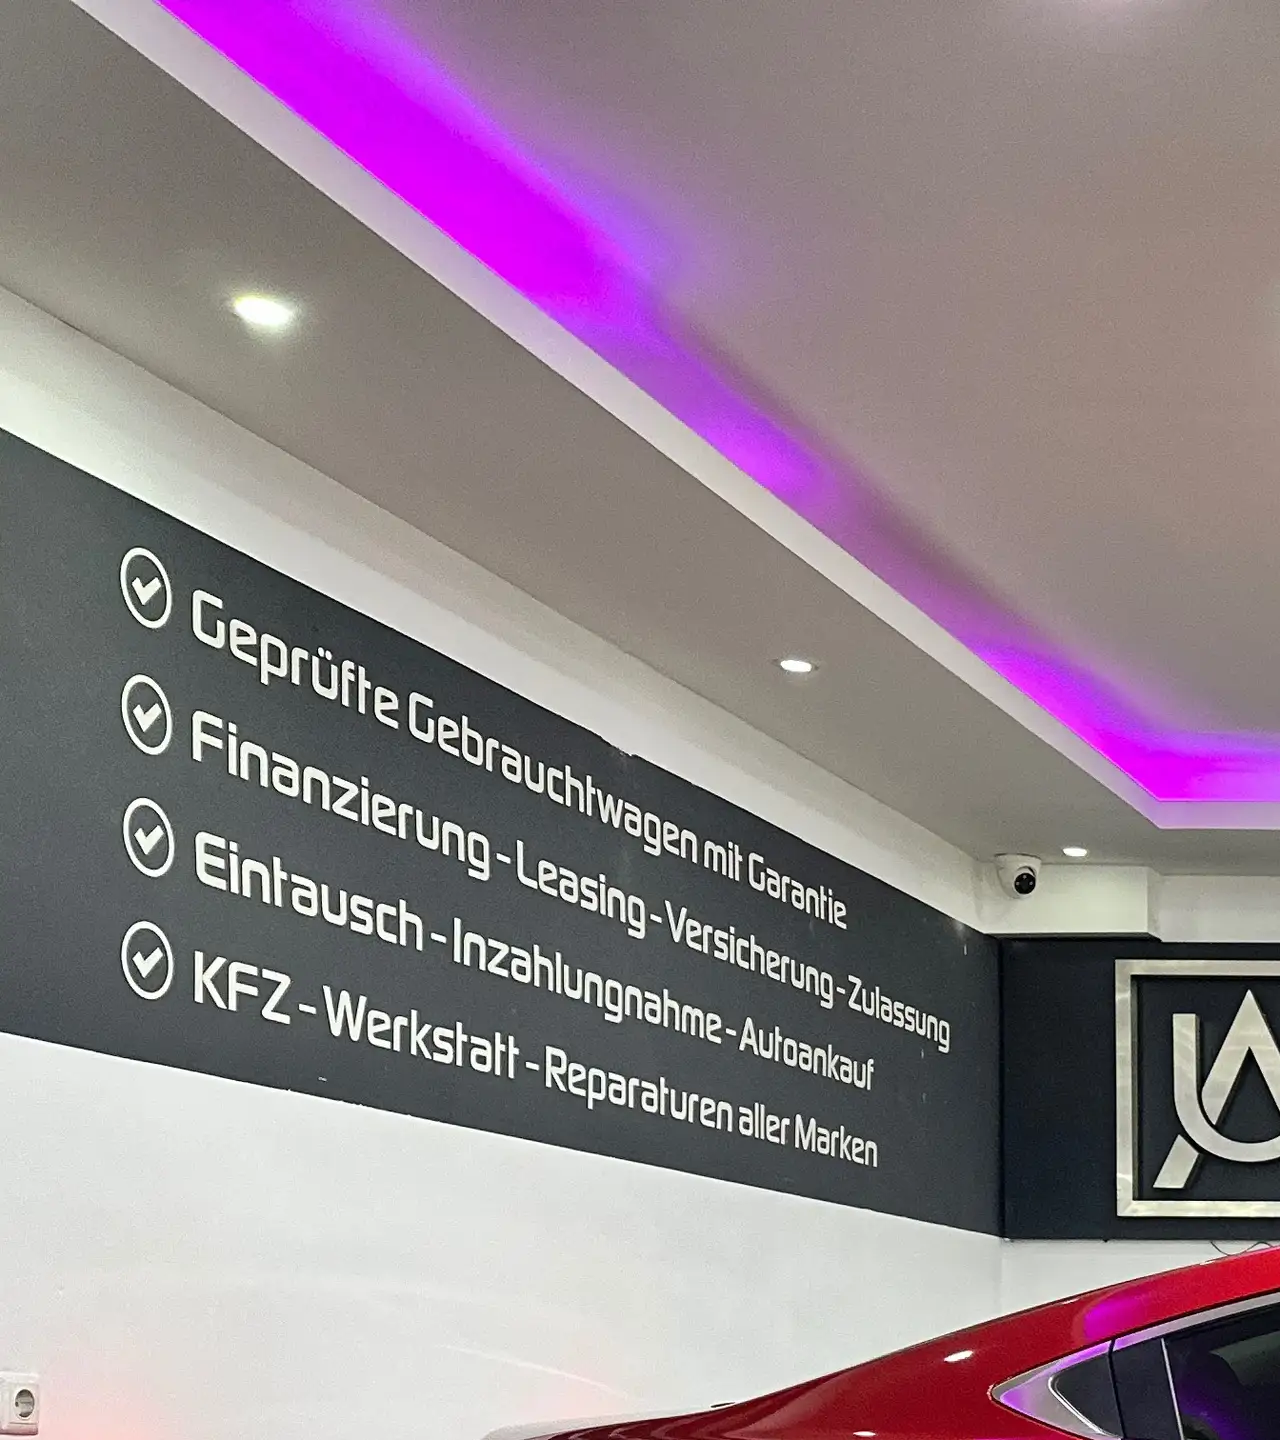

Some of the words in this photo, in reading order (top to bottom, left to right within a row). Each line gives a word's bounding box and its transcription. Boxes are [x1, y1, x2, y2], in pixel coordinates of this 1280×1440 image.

[192, 589, 399, 729] Geprüfte
[408, 691, 697, 863] Gebrauchtwagen
[704, 841, 743, 881] mit
[748, 852, 847, 930] Garantie
[192, 710, 490, 881] Finanzierung
[517, 839, 646, 939] Leasing
[664, 900, 834, 1009] Versicherung
[848, 974, 950, 1054] Zulassung
[194, 950, 291, 1025] KFZ
[323, 985, 520, 1079] Werkstatt
[545, 1045, 733, 1133] Reparaturen
[738, 1103, 790, 1145] aller
[795, 1114, 878, 1168] Marken
[195, 831, 423, 951] Eintausch
[453, 917, 722, 1044] Inzahlungnahme
[738, 1016, 874, 1091] Autoankauf
